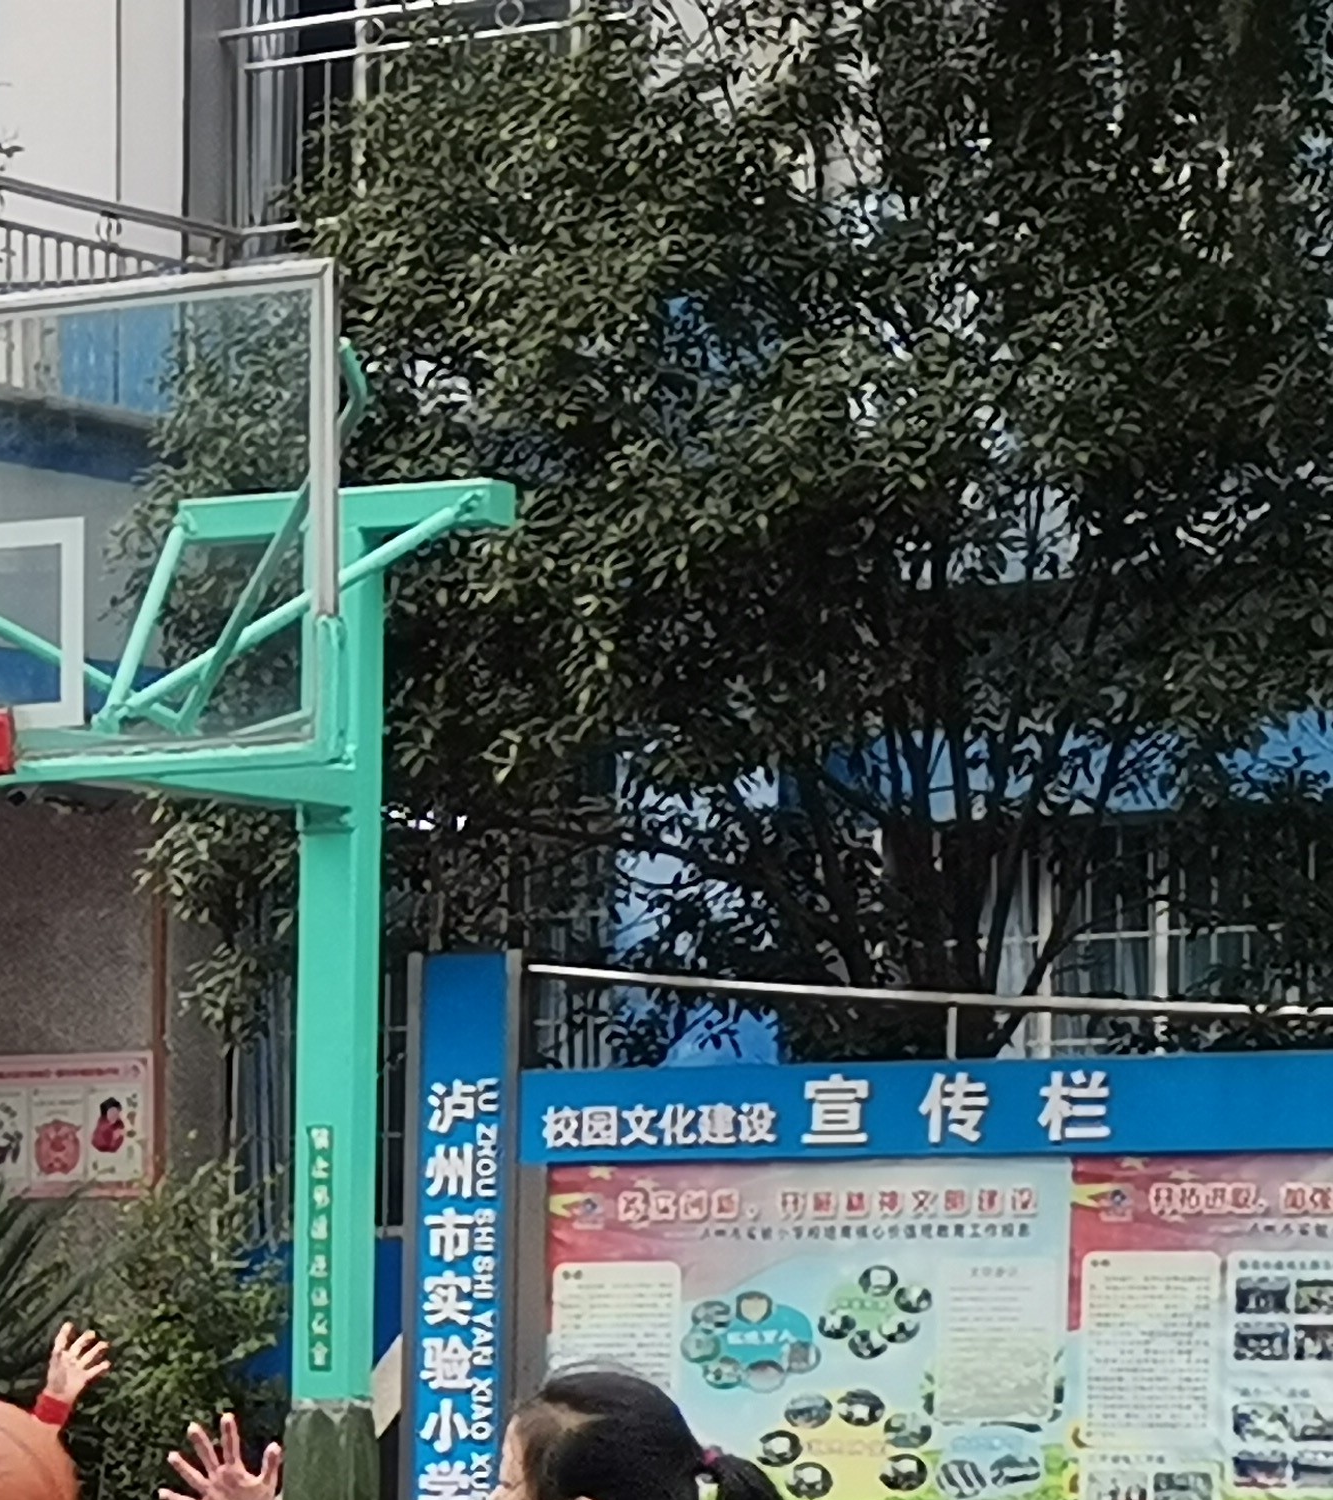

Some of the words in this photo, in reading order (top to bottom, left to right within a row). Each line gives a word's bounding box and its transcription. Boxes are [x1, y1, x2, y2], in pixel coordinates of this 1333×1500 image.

[541, 1103, 778, 1150] 校园文化建设
[800, 1070, 1112, 1146] 宣传栏
[475, 1122, 498, 1198] ZHOU
